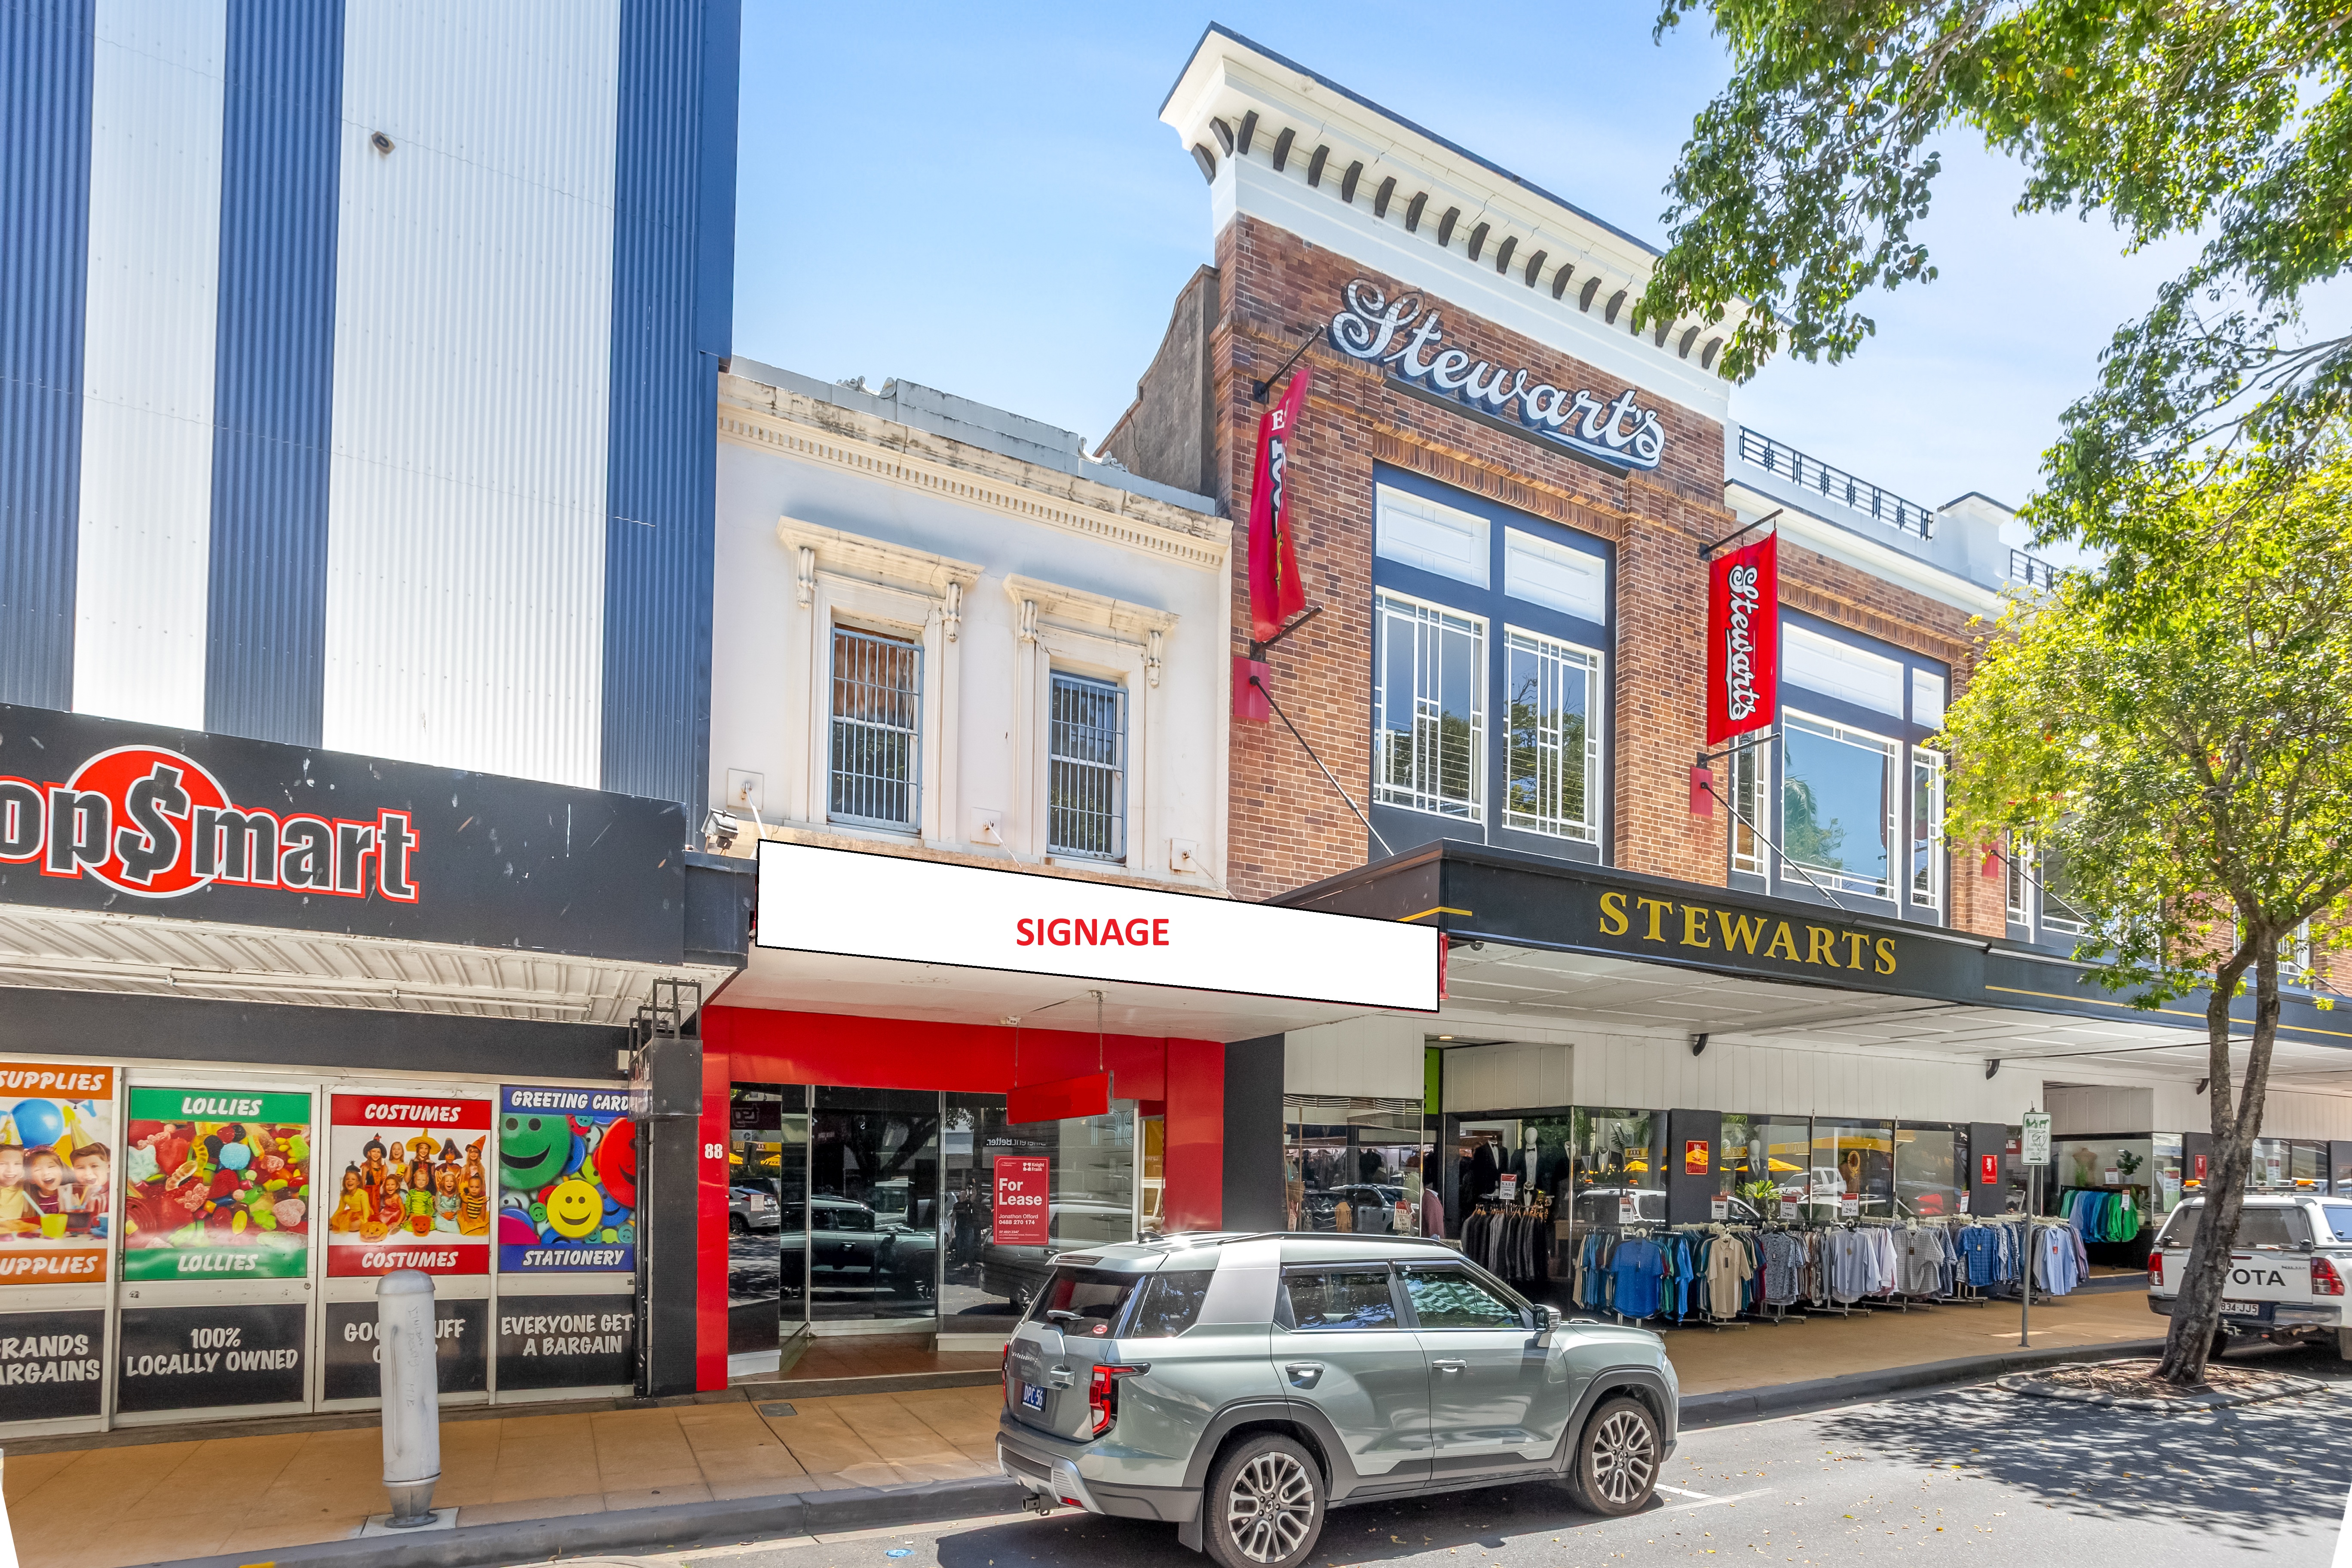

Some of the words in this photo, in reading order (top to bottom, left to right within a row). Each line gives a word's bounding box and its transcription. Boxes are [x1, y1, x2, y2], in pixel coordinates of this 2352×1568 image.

[1599, 891, 1897, 975] STEWARTS
[181, 1097, 262, 1116] LOLLIES
[511, 1090, 588, 1109] GREETING
[364, 1103, 462, 1122] COSTUMES
[704, 1143, 723, 1159] 88
[999, 1178, 1023, 1191] For
[999, 1192, 1042, 1206] Lease
[178, 1254, 259, 1272] LOLLIES
[361, 1251, 459, 1269] COSTUMES
[523, 1250, 625, 1267] STATIONERY
[2226, 1268, 2286, 1286] OTA
[501, 1314, 597, 1335] EVERYONE
[600, 1314, 633, 1332] GET
[0, 1334, 89, 1360] RANDS
[190, 1327, 242, 1349] 100%
[522, 1338, 537, 1357] A
[543, 1335, 622, 1356] BARGAIN
[126, 1352, 220, 1377] LOCALLY
[226, 1349, 298, 1371] OWNED
